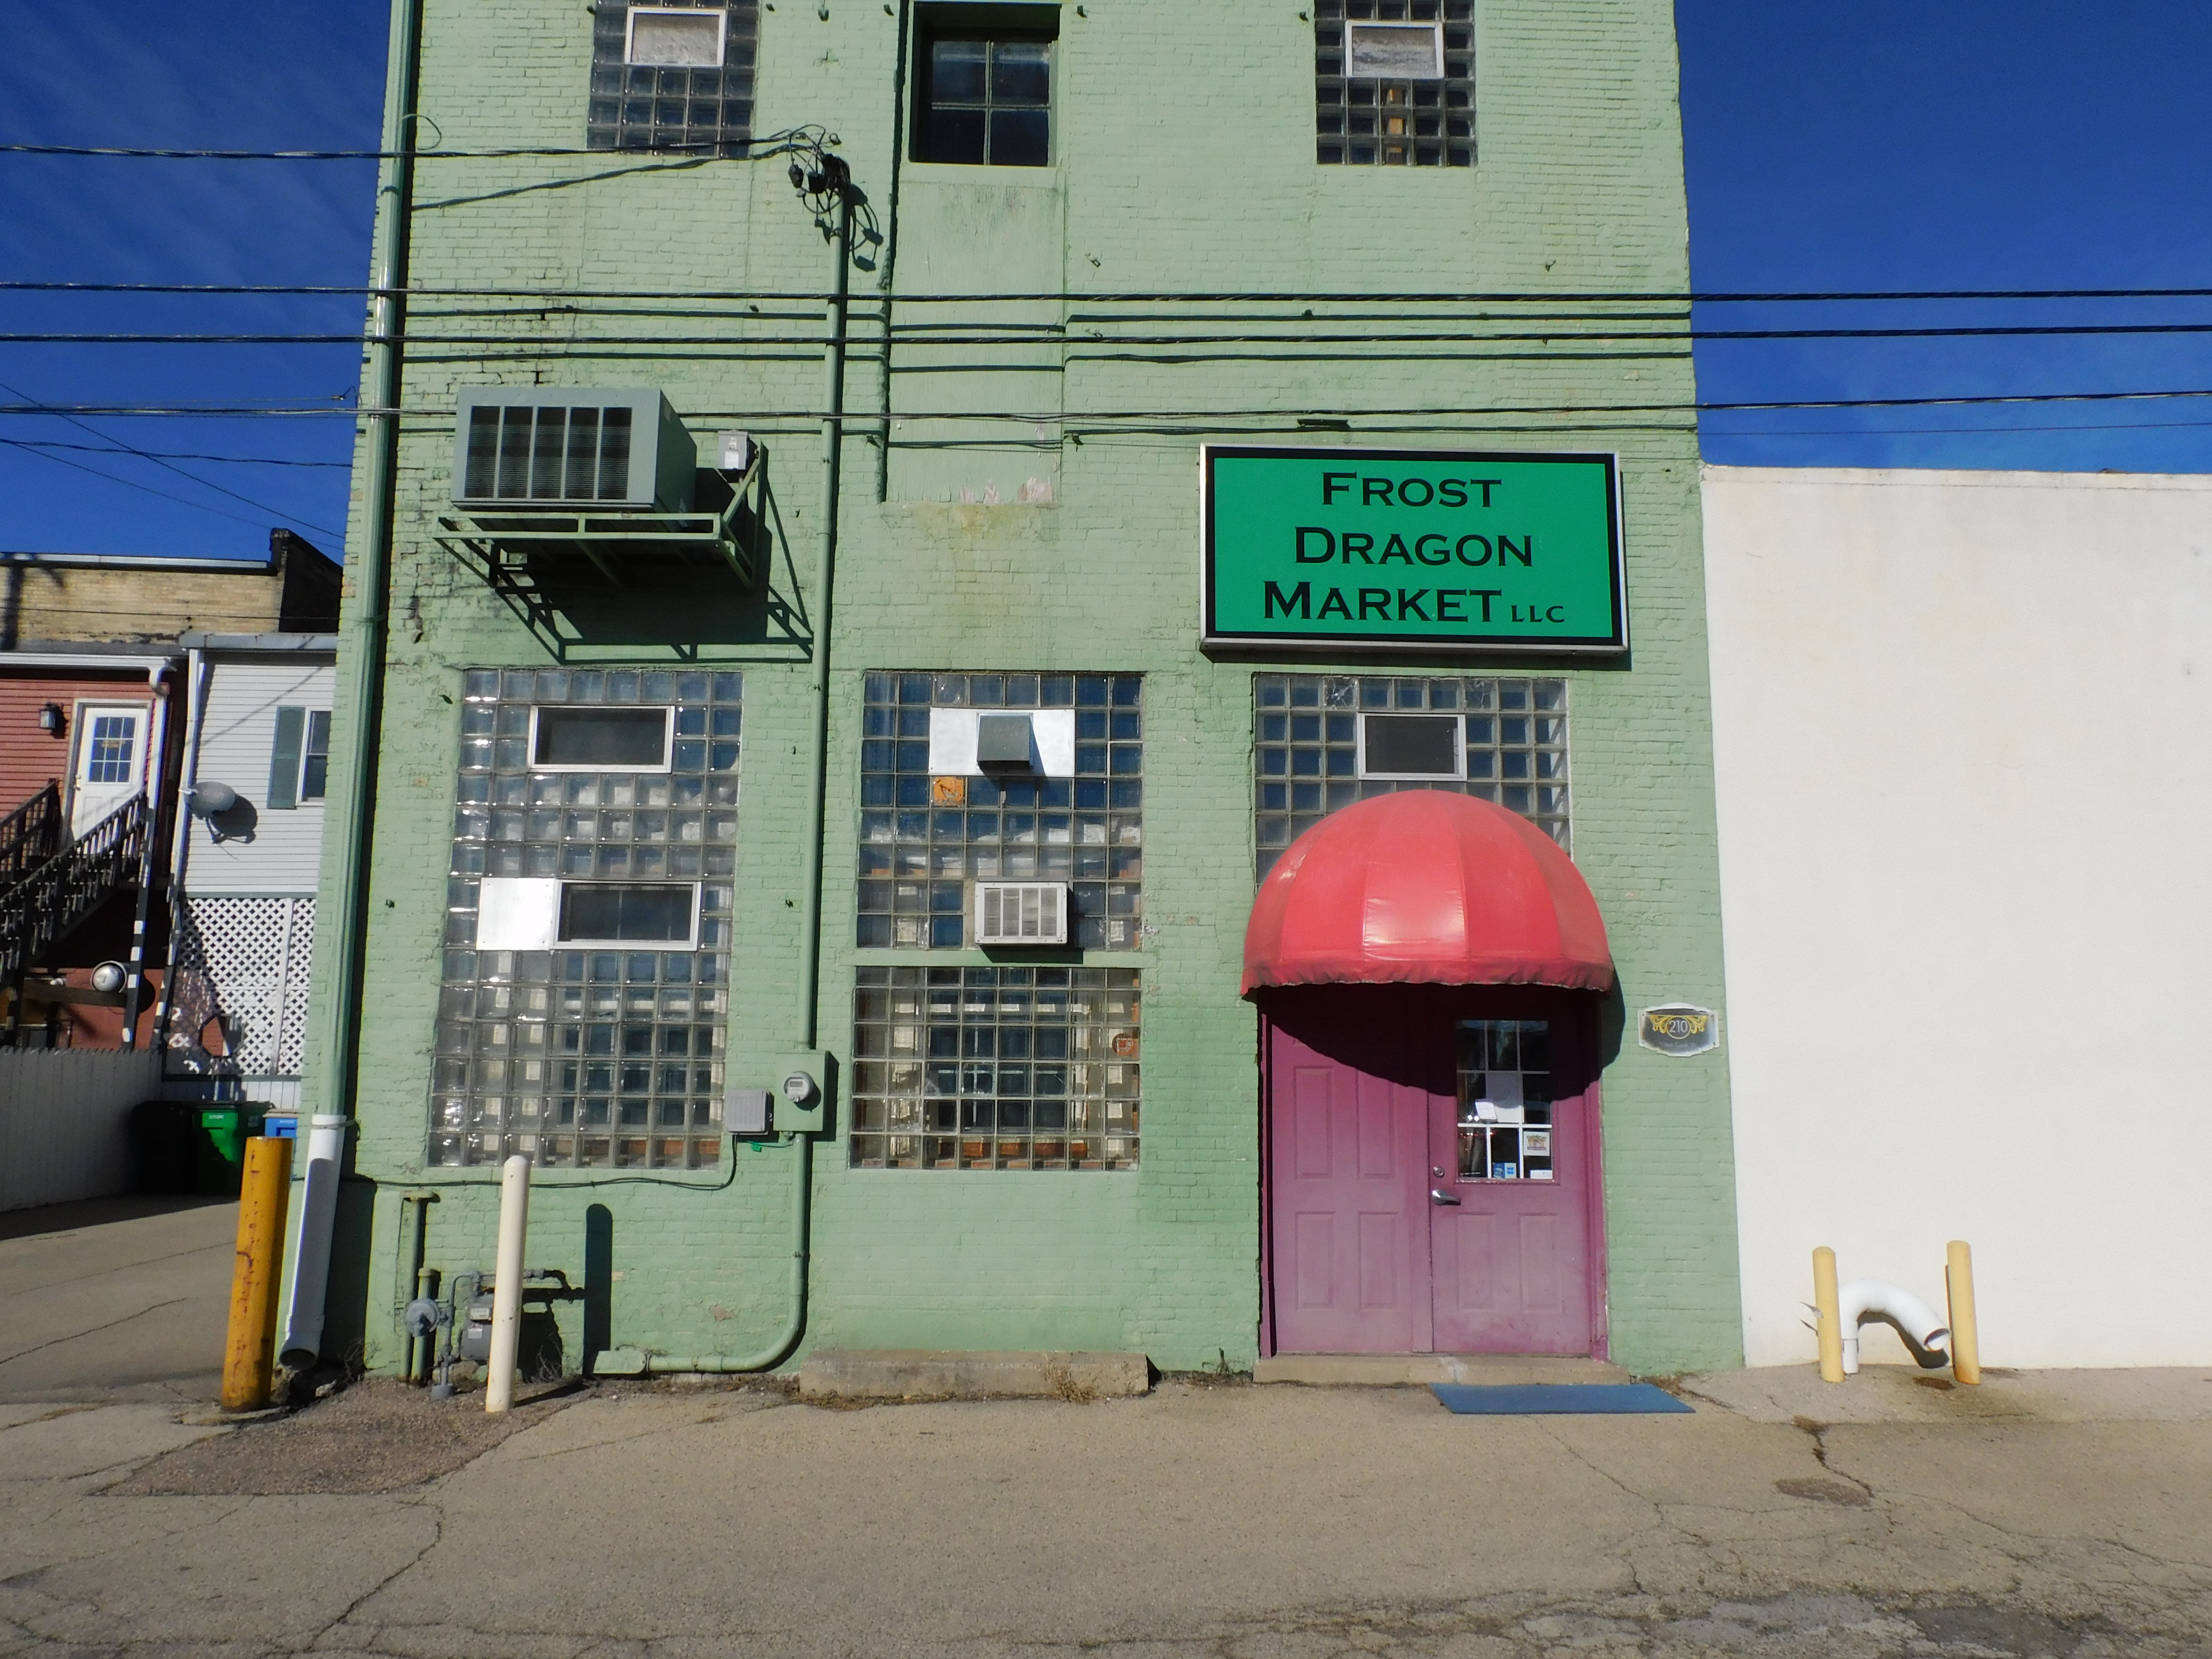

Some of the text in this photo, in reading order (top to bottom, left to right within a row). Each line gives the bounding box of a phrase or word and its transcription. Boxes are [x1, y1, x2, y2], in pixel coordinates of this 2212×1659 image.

[1322, 471, 1502, 508] FROST
[1295, 526, 1533, 567] DRAGON
[1263, 581, 1565, 623] MARKET LLC
[1669, 1020, 1688, 1033] 210
